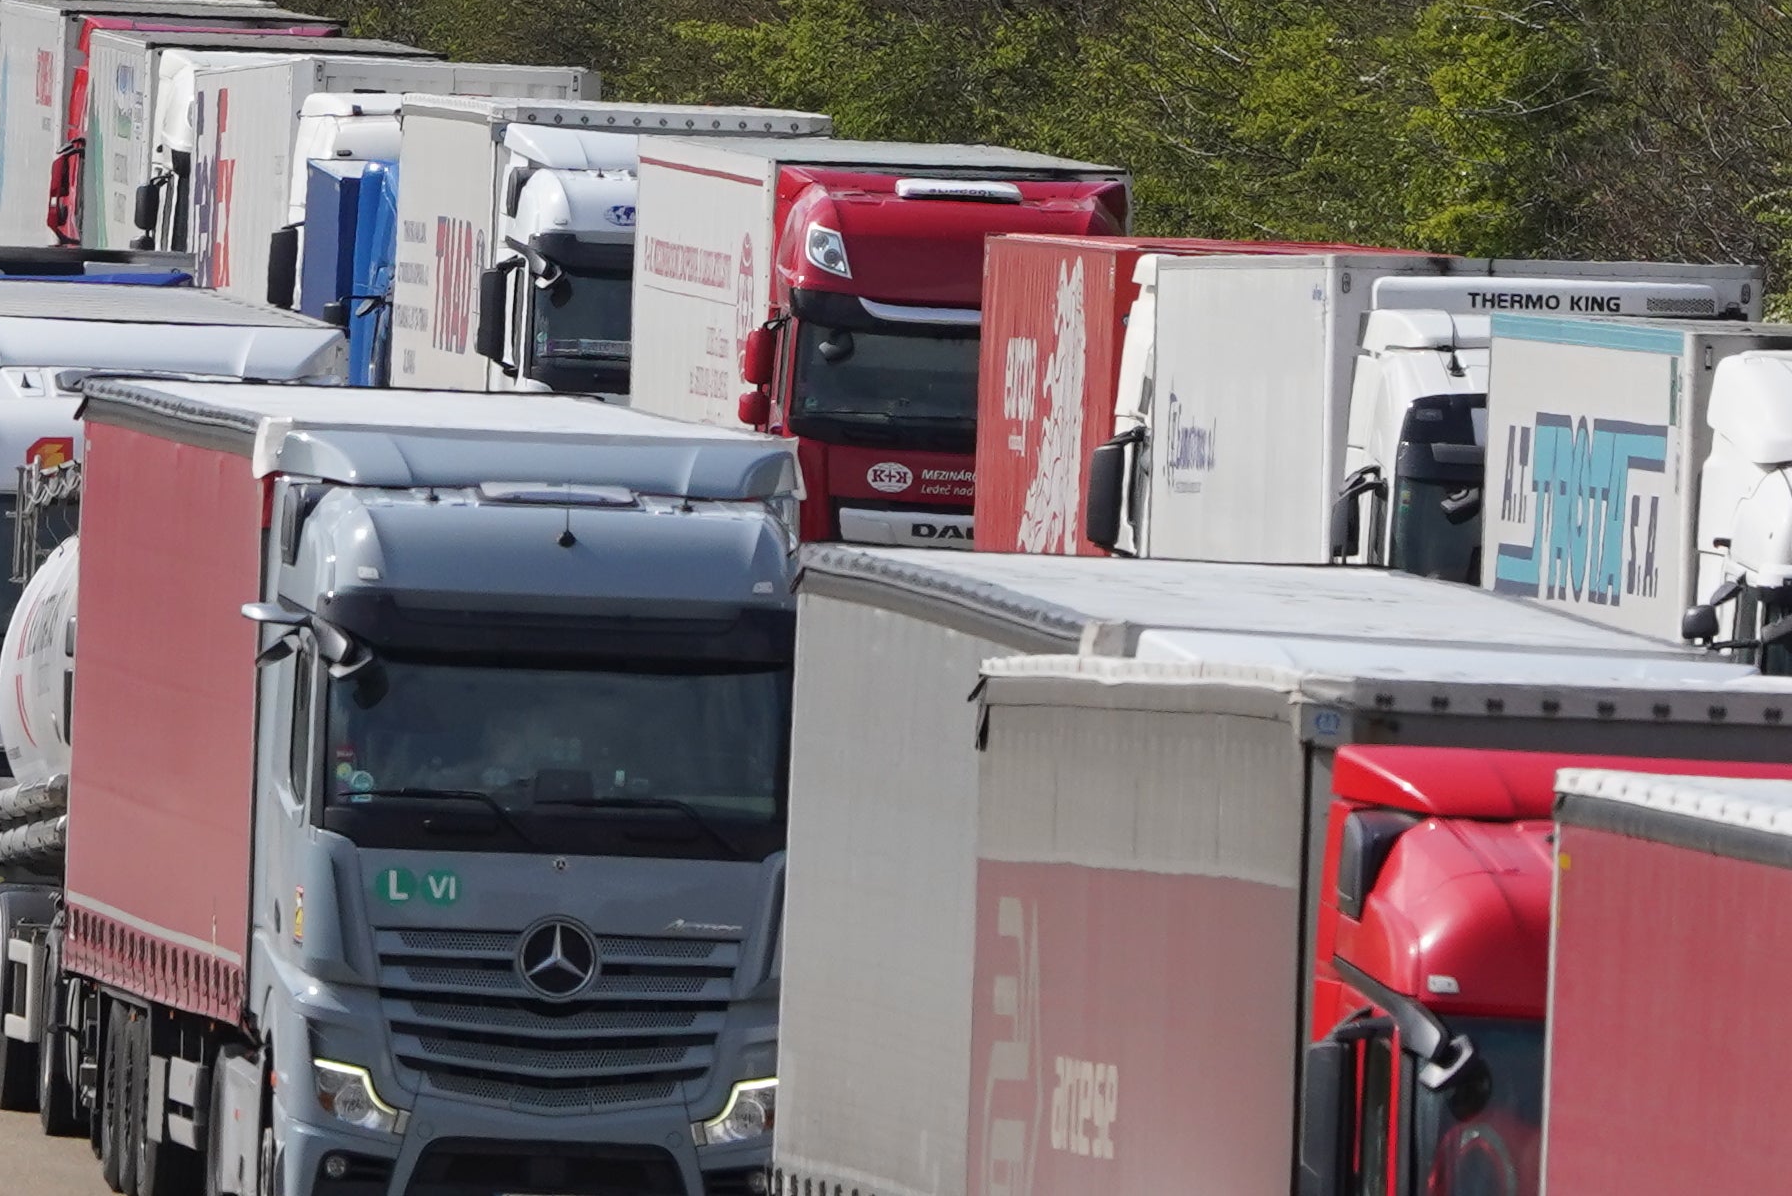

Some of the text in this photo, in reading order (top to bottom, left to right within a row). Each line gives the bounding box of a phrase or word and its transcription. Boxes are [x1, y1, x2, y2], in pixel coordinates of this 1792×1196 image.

[1467, 292, 1621, 313] THERMO KING
[388, 869, 456, 901] L VI
